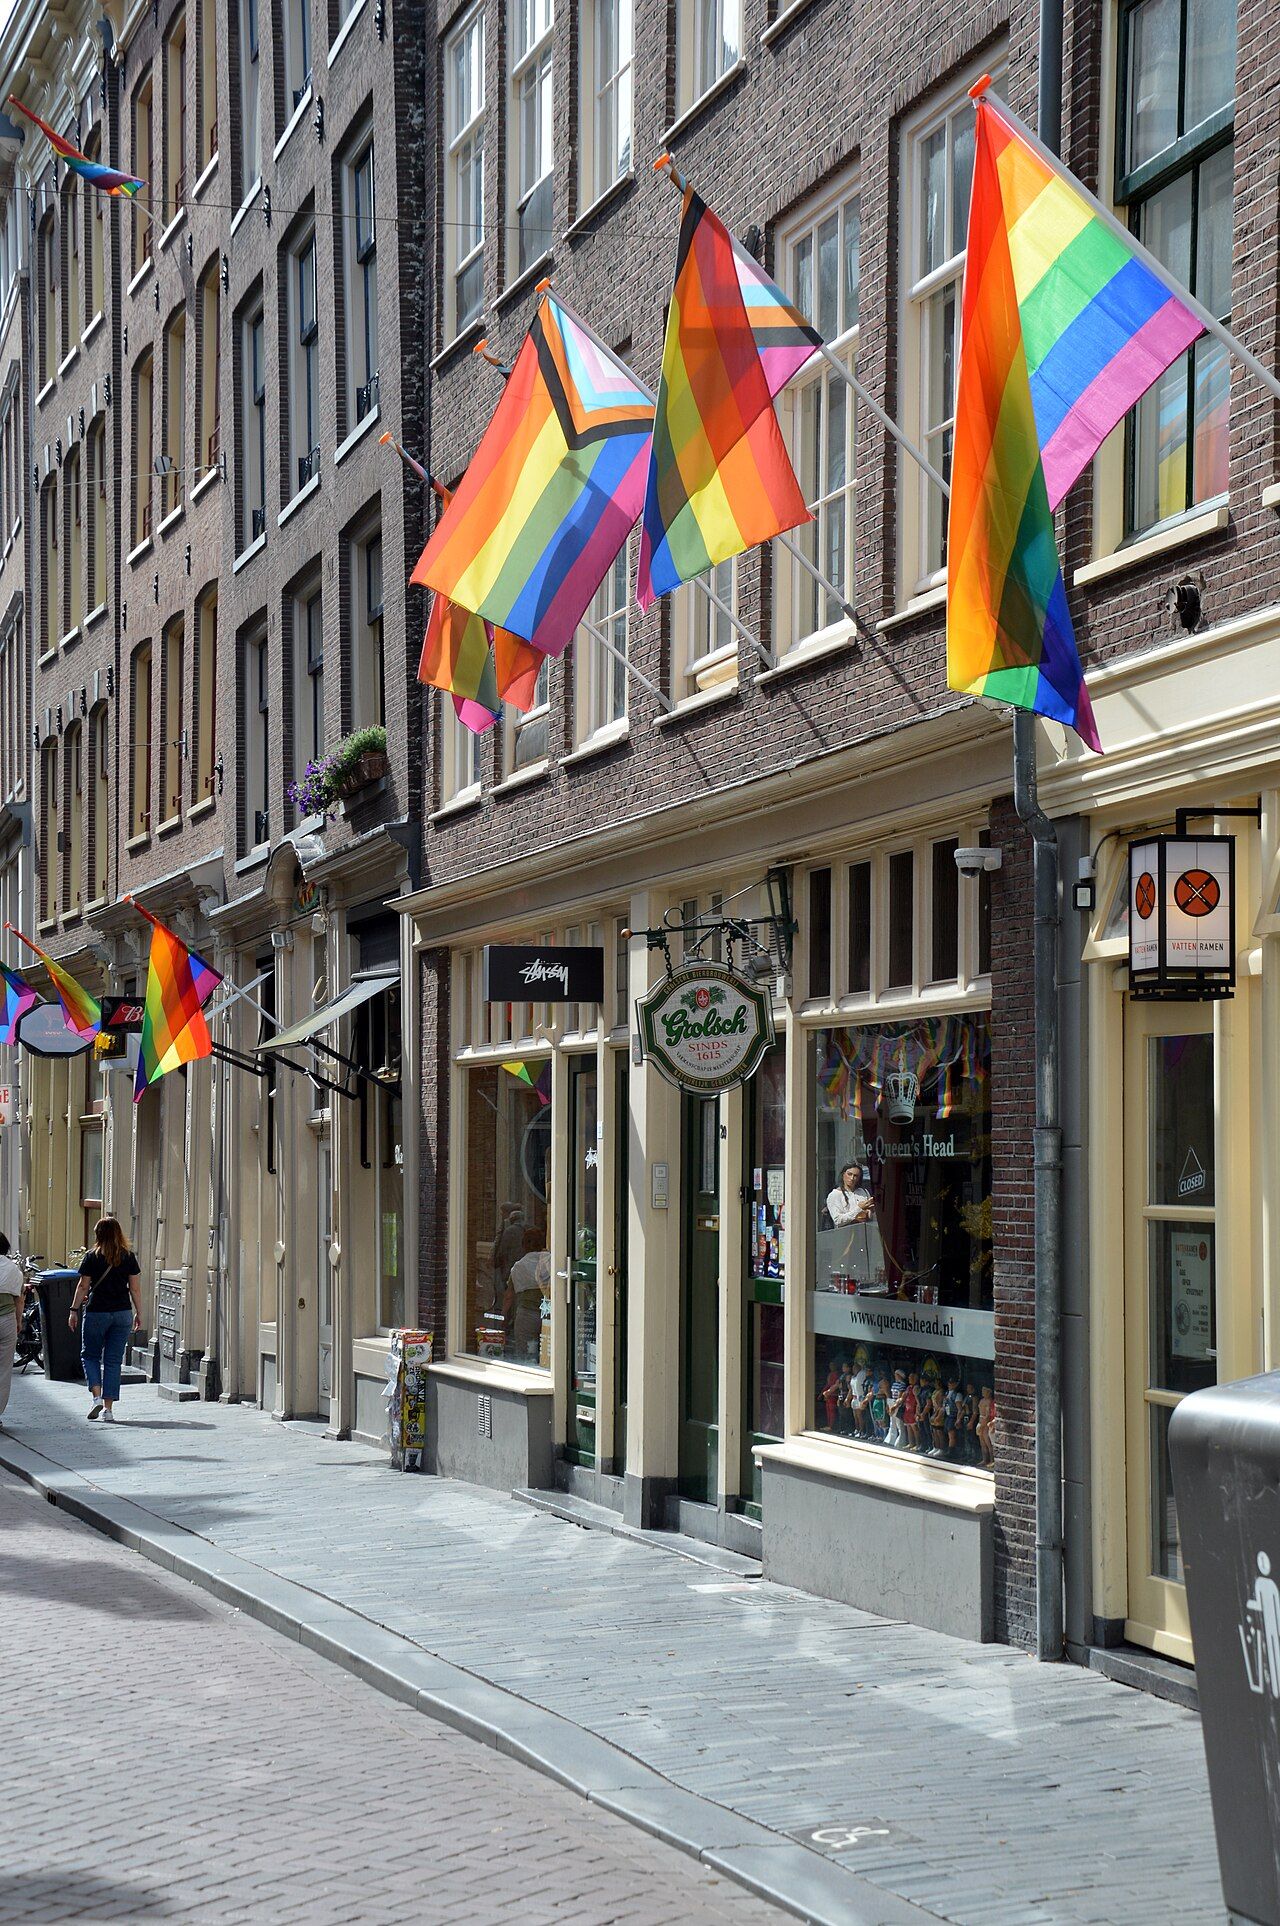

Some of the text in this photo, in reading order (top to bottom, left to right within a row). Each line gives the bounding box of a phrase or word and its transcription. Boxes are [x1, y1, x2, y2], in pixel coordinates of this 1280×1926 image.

[1146, 943, 1158, 952] RAMEN
[1171, 942, 1224, 951] VATTEN RAMEN
[661, 1004, 748, 1047] Grolsch
[688, 1040, 728, 1053] SINDS
[697, 1050, 721, 1061] 1615
[875, 1135, 920, 1161] Queen's
[922, 1133, 954, 1157] Head
[1179, 1174, 1203, 1193] CLOSED
[850, 1311, 954, 1337] www.queenshead.nl
